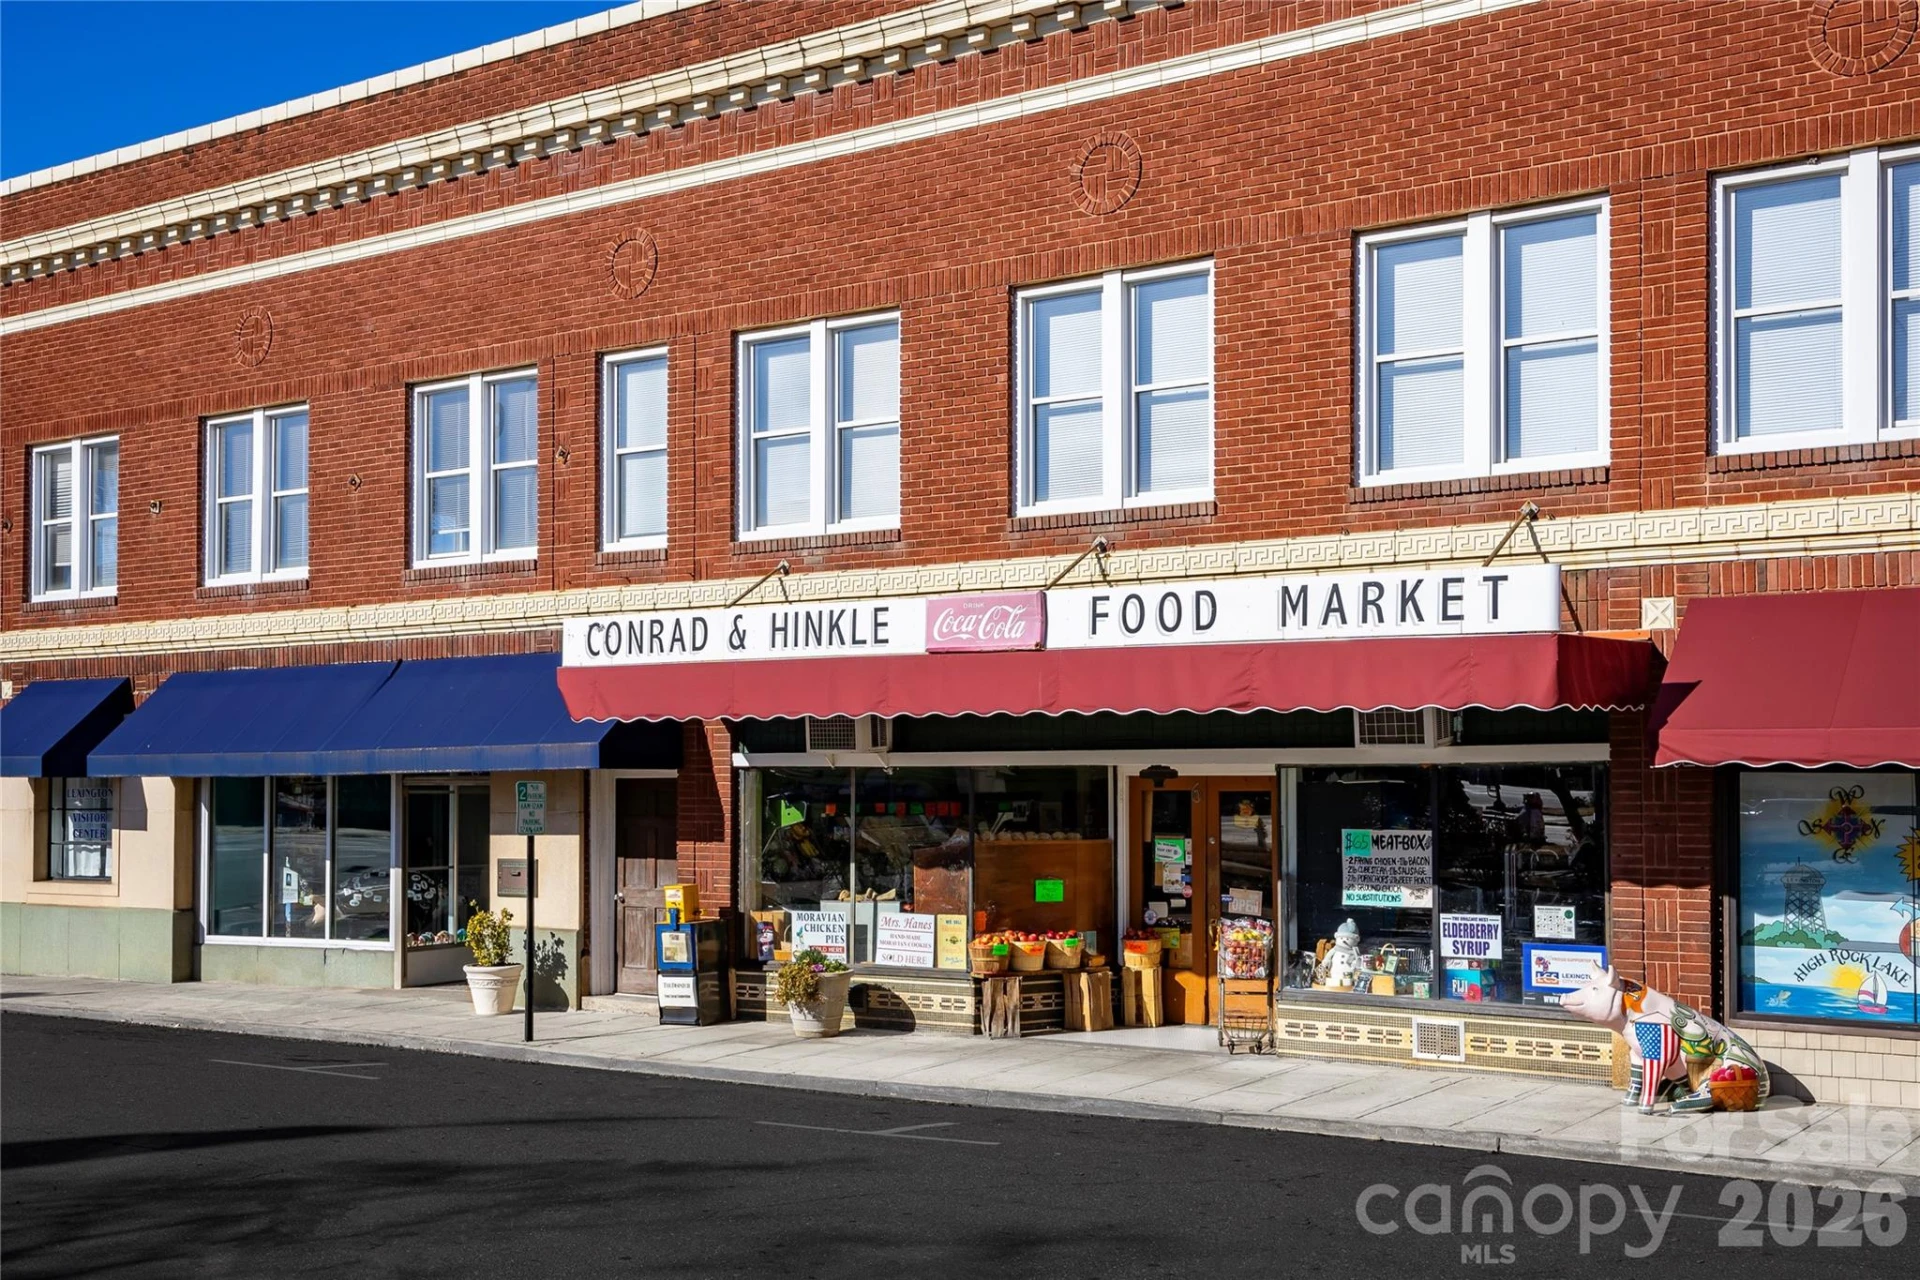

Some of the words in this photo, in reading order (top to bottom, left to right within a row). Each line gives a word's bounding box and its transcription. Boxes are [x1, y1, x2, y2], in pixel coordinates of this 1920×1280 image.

[1091, 589, 1217, 636] FOOD
[1281, 575, 1508, 627] MARKET
[933, 604, 1029, 642] Coca-Cola
[586, 616, 708, 657] CONRAD
[729, 612, 746, 651] &
[770, 607, 890, 649] HINKLE
[67, 788, 113, 798] LEXINGTON
[519, 786, 526, 800] 2
[72, 813, 106, 822] VISITOR
[73, 829, 106, 839] CENTER
[1345, 832, 1369, 852] $65
[1371, 834, 1426, 852] MEAT-BOX
[1374, 857, 1396, 866] CHICKEN
[1408, 856, 1430, 866] BACON
[1397, 867, 1427, 875] SAUSAGE
[1399, 876, 1413, 884] BEEF
[1413, 876, 1432, 885] ROAST
[1346, 893, 1355, 901] NO
[1356, 893, 1402, 903] SUBSTITUTIONS
[1231, 897, 1259, 914] OPEN
[796, 912, 845, 922] MORAVIAN
[880, 916, 901, 928] Mrs.
[903, 917, 933, 930] Hanes
[804, 923, 844, 933] CHICKEN
[1442, 922, 1499, 940] ELDERBERRY
[825, 934, 845, 944] PIES
[1452, 940, 1490, 956] SYRUP
[881, 953, 903, 963] SOLD
[905, 955, 927, 965] HERE
[1793, 951, 1827, 983] HIGH
[1829, 947, 1872, 973] ROCK
[1872, 956, 1912, 988] LAKE
[1536, 972, 1558, 984] LCS
[1452, 979, 1468, 993] FIJI
